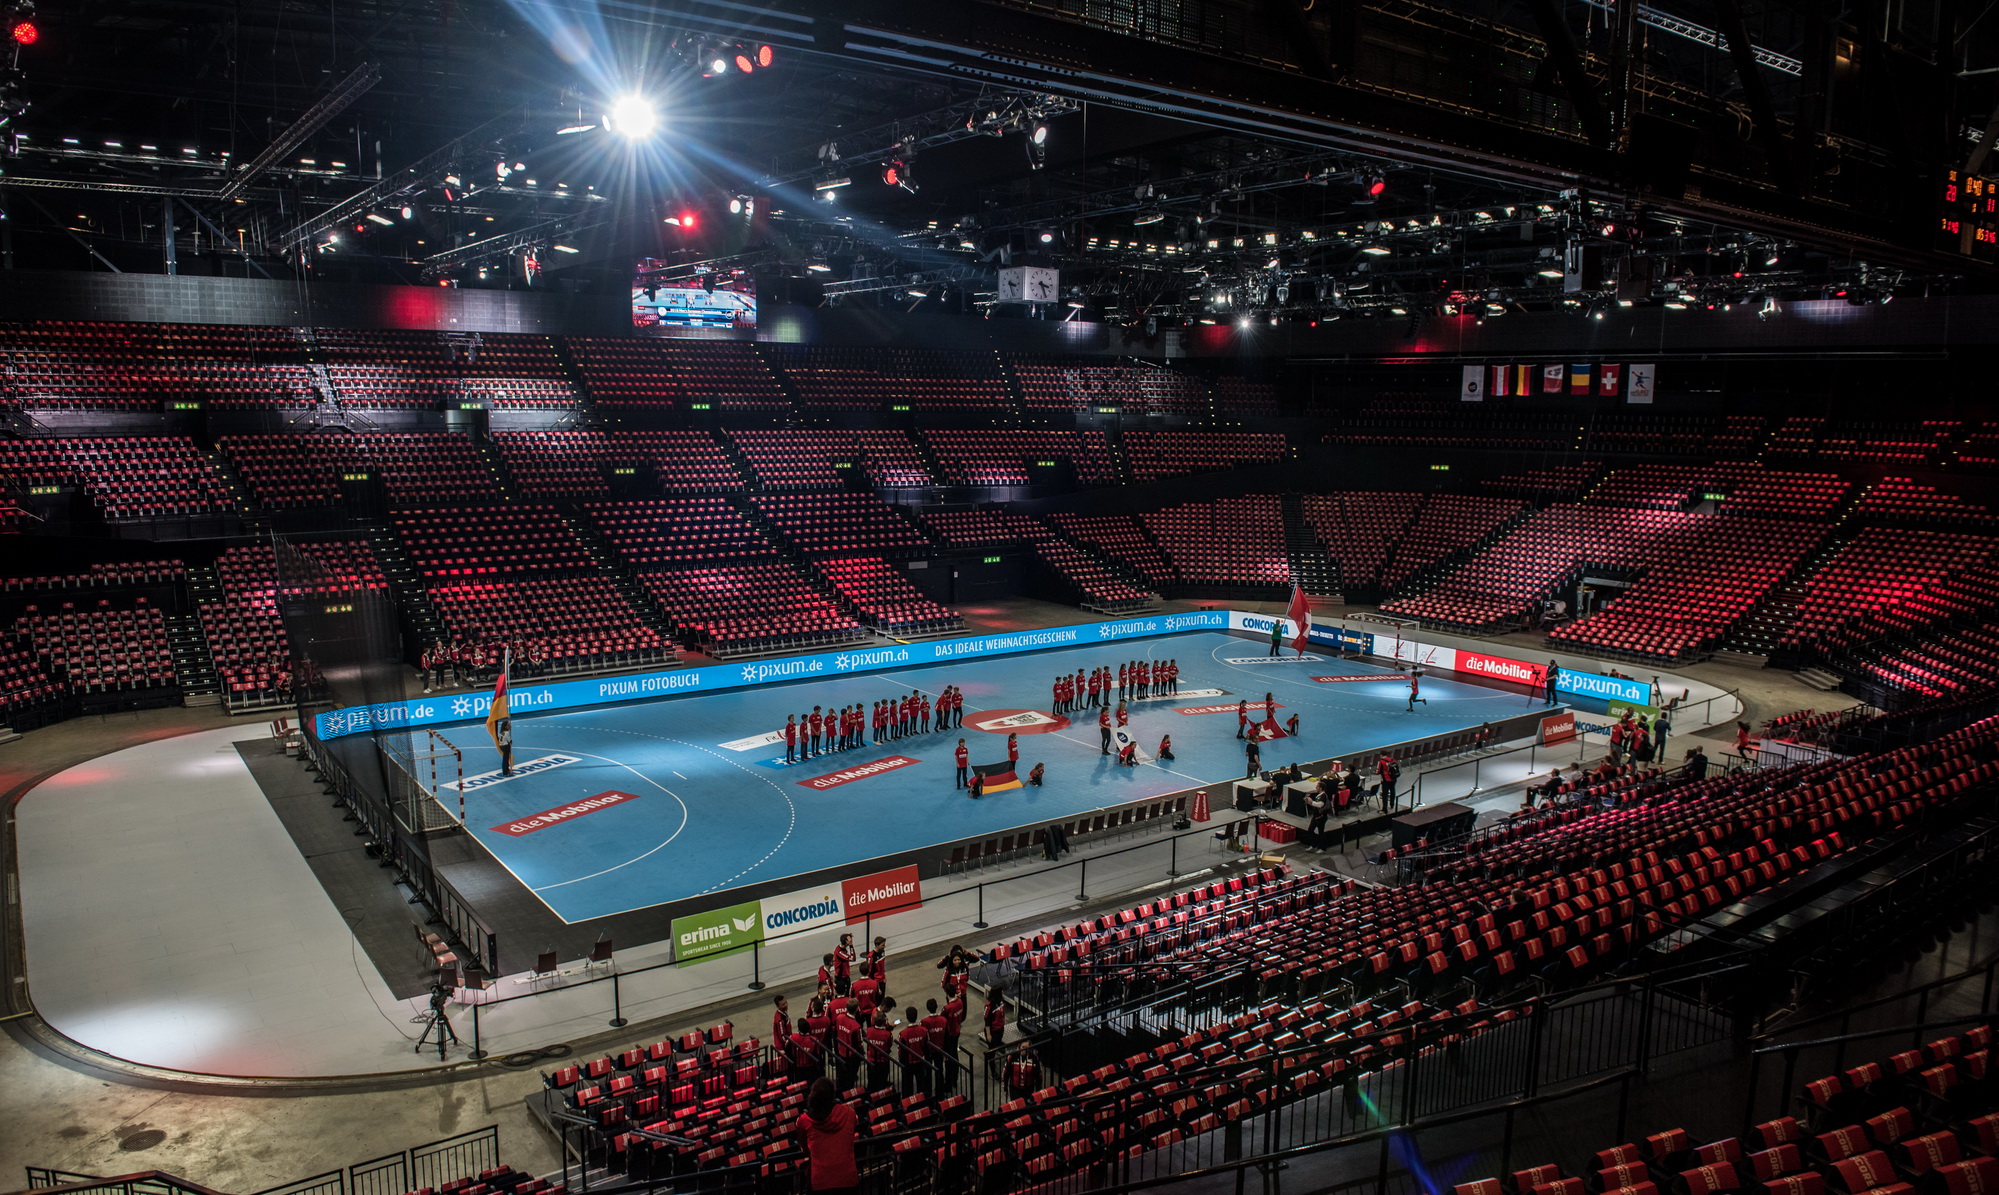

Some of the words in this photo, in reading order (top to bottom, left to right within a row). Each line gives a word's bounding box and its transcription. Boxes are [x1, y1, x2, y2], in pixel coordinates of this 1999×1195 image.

[1111, 620, 1157, 639] pixum.de
[1176, 614, 1222, 632] pixum.ch
[935, 645, 953, 657] DAS
[955, 640, 983, 654] IDEALE
[985, 630, 1077, 651] WEIHNACHTSGESCHENK
[759, 658, 823, 682] pixum.de
[852, 648, 909, 671] pixum.ch
[1466, 656, 1483, 671] die
[1484, 659, 1533, 680] Mobiliar
[599, 677, 638, 697] PIXUM
[641, 673, 699, 692] FOTOBUCH
[1573, 675, 1640, 700] pixum.ch
[814, 777, 843, 788] die
[839, 757, 909, 780] Mobiliar
[510, 818, 544, 833] die
[539, 794, 625, 822] Mobiliar
[849, 891, 867, 907] die
[867, 881, 915, 902] Mobiliar
[766, 896, 839, 929] CONCORDIA
[681, 923, 731, 946] erima
[709, 942, 721, 950] SINCE
[839, 1025, 850, 1034] STAFF
